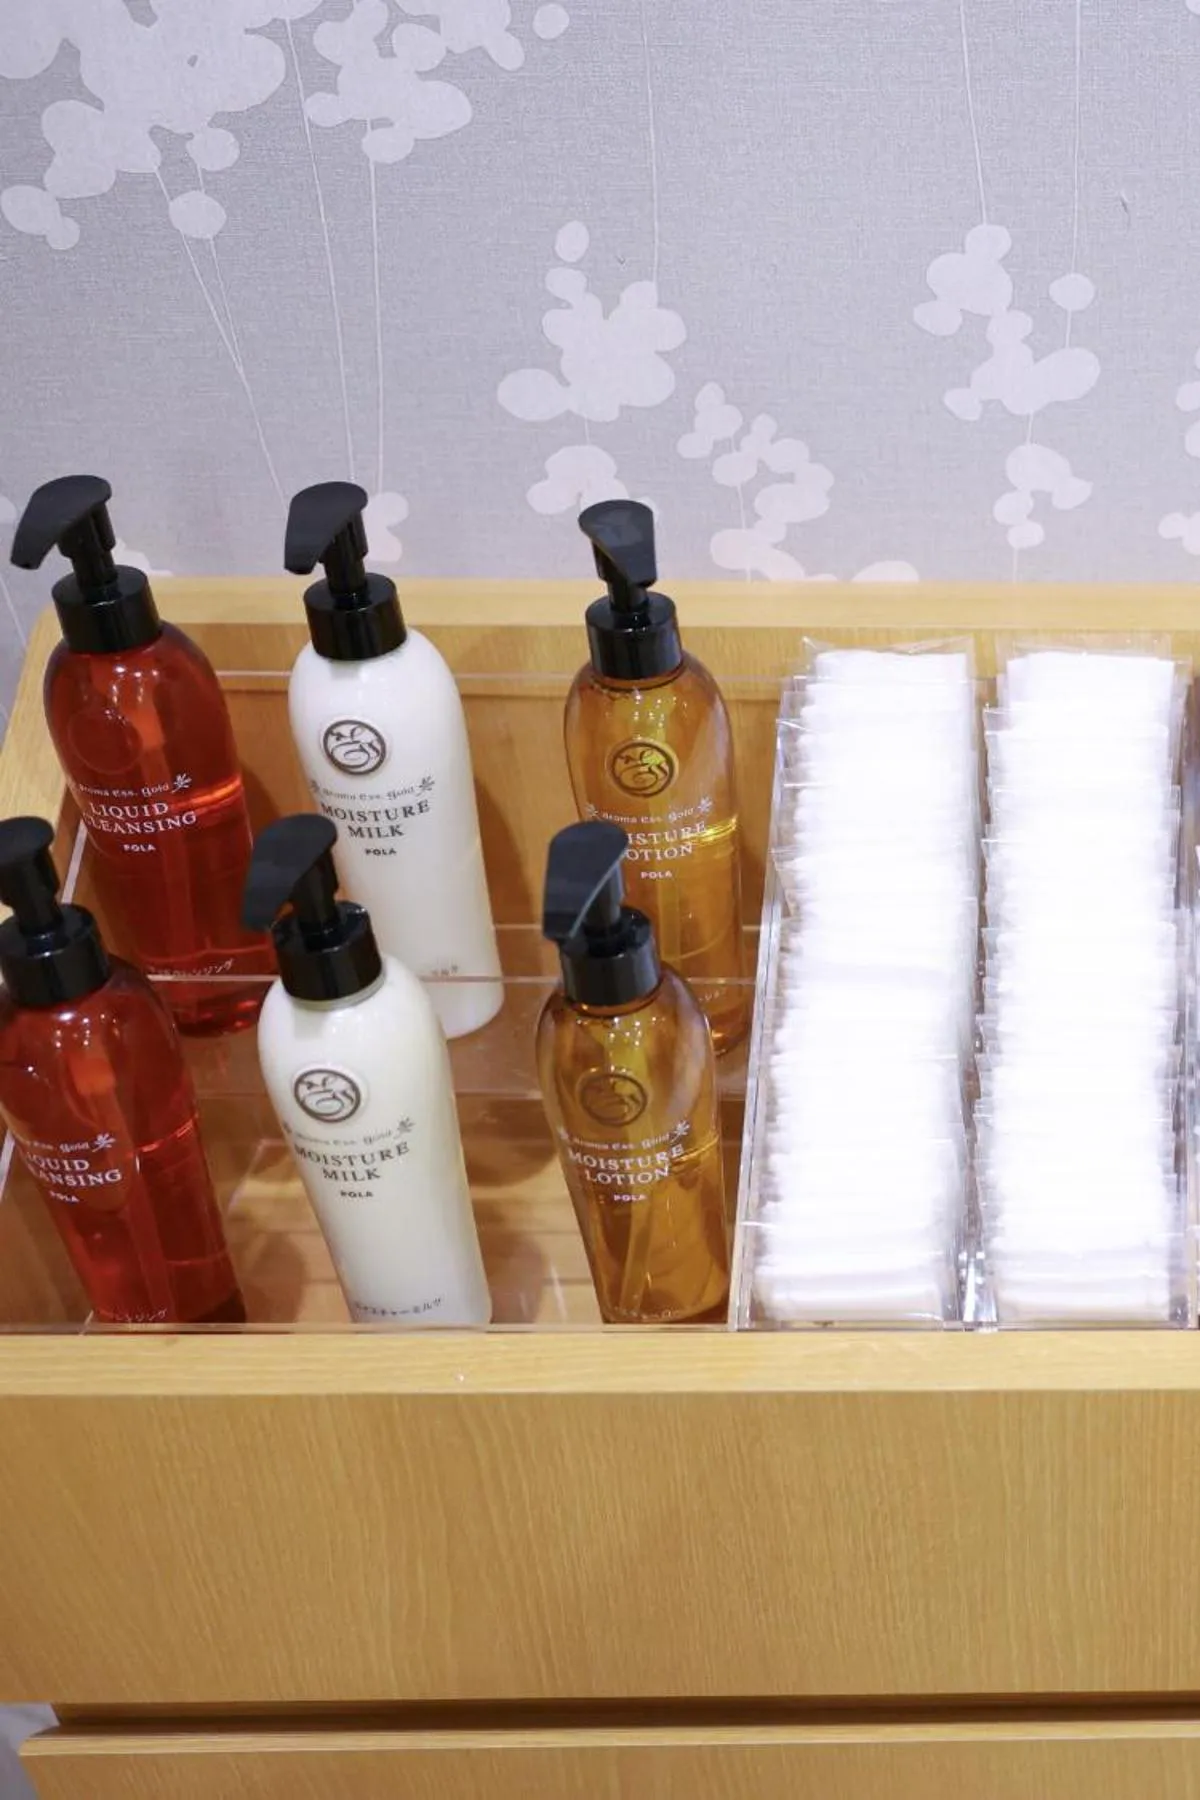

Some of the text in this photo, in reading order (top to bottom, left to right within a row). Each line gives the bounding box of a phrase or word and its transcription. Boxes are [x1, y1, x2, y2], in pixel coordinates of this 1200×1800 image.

[89, 801, 169, 820] LIQUID
[320, 799, 431, 824] MOISTURE
[82, 810, 198, 835] CLEANSING
[347, 823, 405, 840] MILK
[626, 820, 707, 847] ISTURE
[123, 842, 157, 853] POLA
[365, 847, 397, 857] POLA
[624, 842, 693, 863] OTION
[640, 869, 673, 880] POLA
[294, 1141, 410, 1167] MOISTURE
[568, 1144, 685, 1171] MOISTURE
[322, 1167, 381, 1182] MILK
[585, 1161, 671, 1186] LOTION
[340, 1190, 374, 1199] POLA
[613, 1193, 648, 1203] POLA
